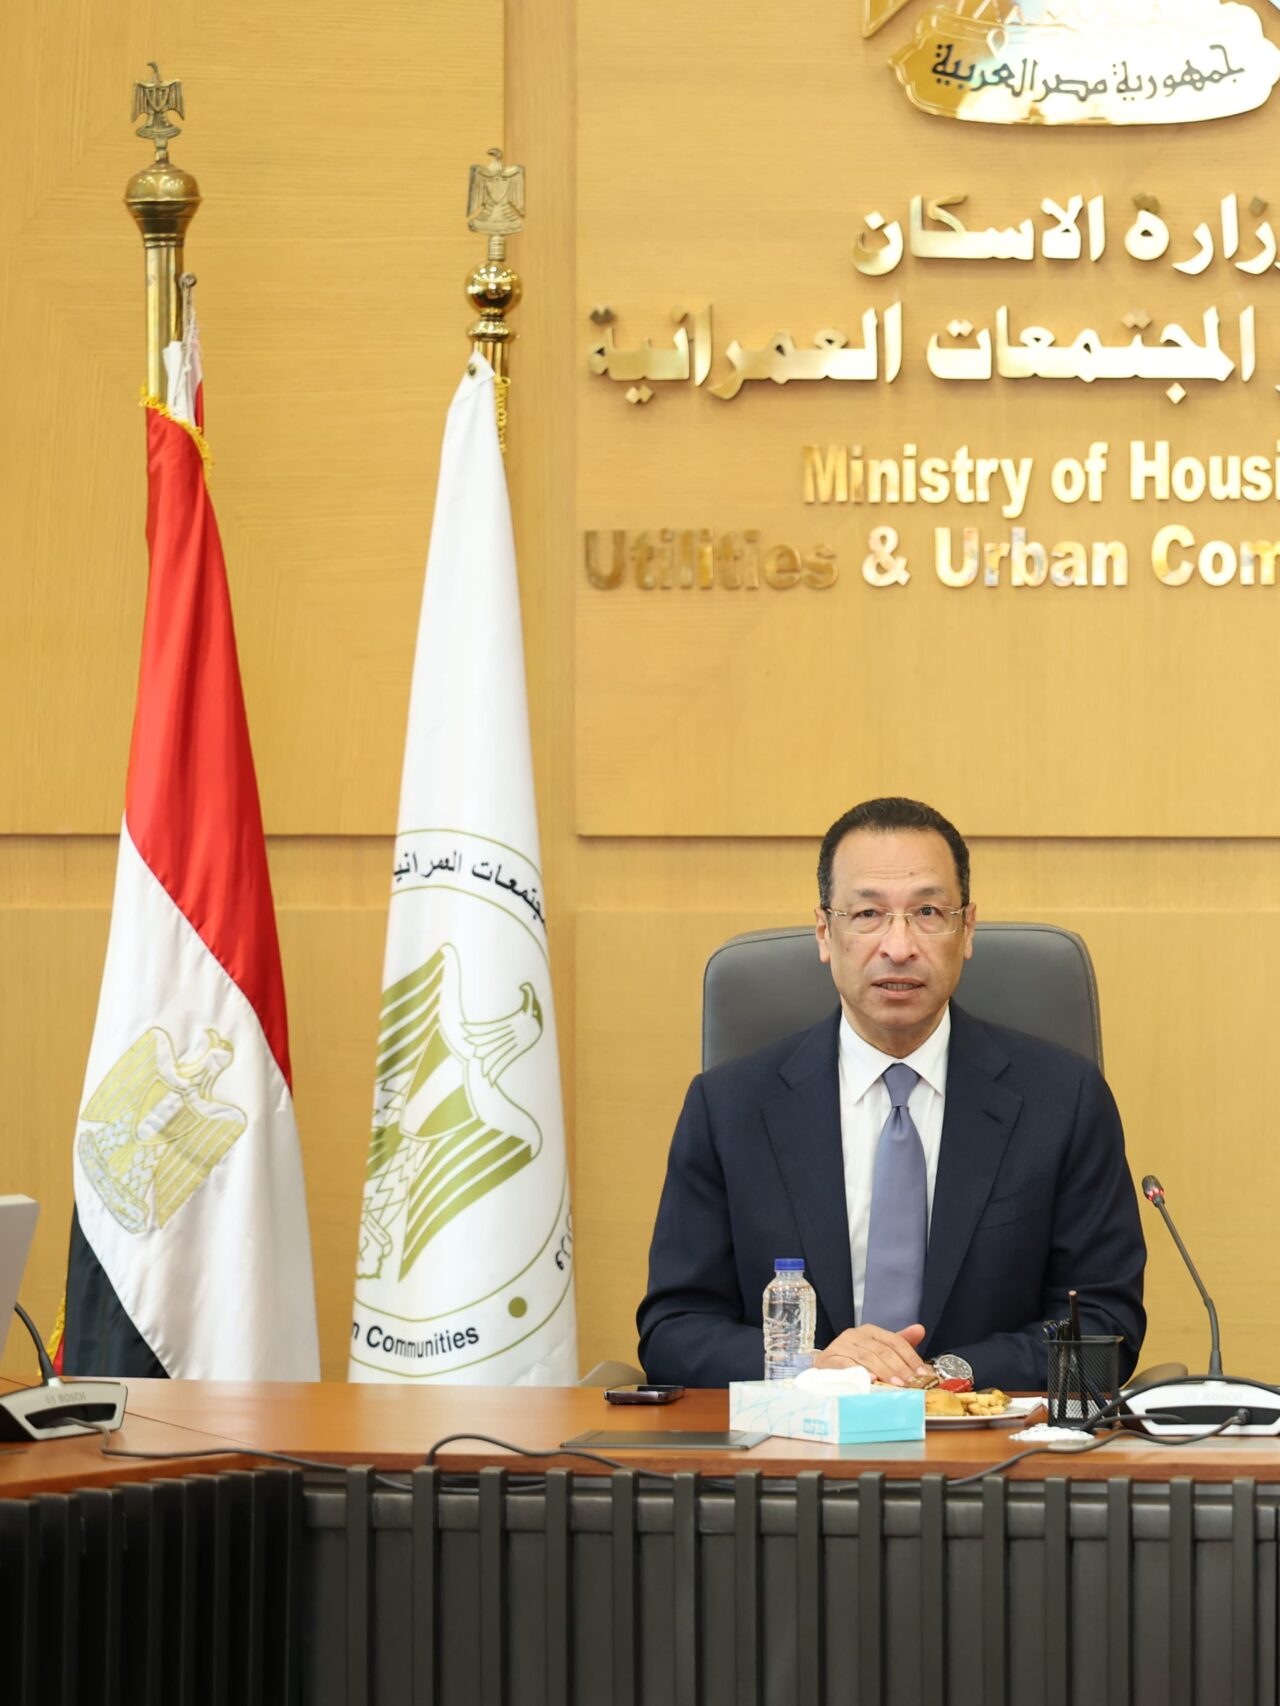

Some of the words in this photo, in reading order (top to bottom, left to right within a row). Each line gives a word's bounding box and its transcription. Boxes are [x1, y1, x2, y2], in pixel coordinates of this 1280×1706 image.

[930, 43, 1038, 98] العربية
[1034, 75, 1108, 103] مصر
[1113, 44, 1245, 100] جمهورية
[851, 193, 1106, 276] الاسكان
[586, 301, 903, 405] العمرانية
[926, 304, 1256, 405] المجتمعات
[802, 444, 1034, 519] Ministry
[1051, 442, 1108, 502] of
[583, 528, 840, 591] Utilities
[862, 525, 911, 587] &
[934, 526, 1129, 588] Urban
[366, 1325, 480, 1359] Communities
